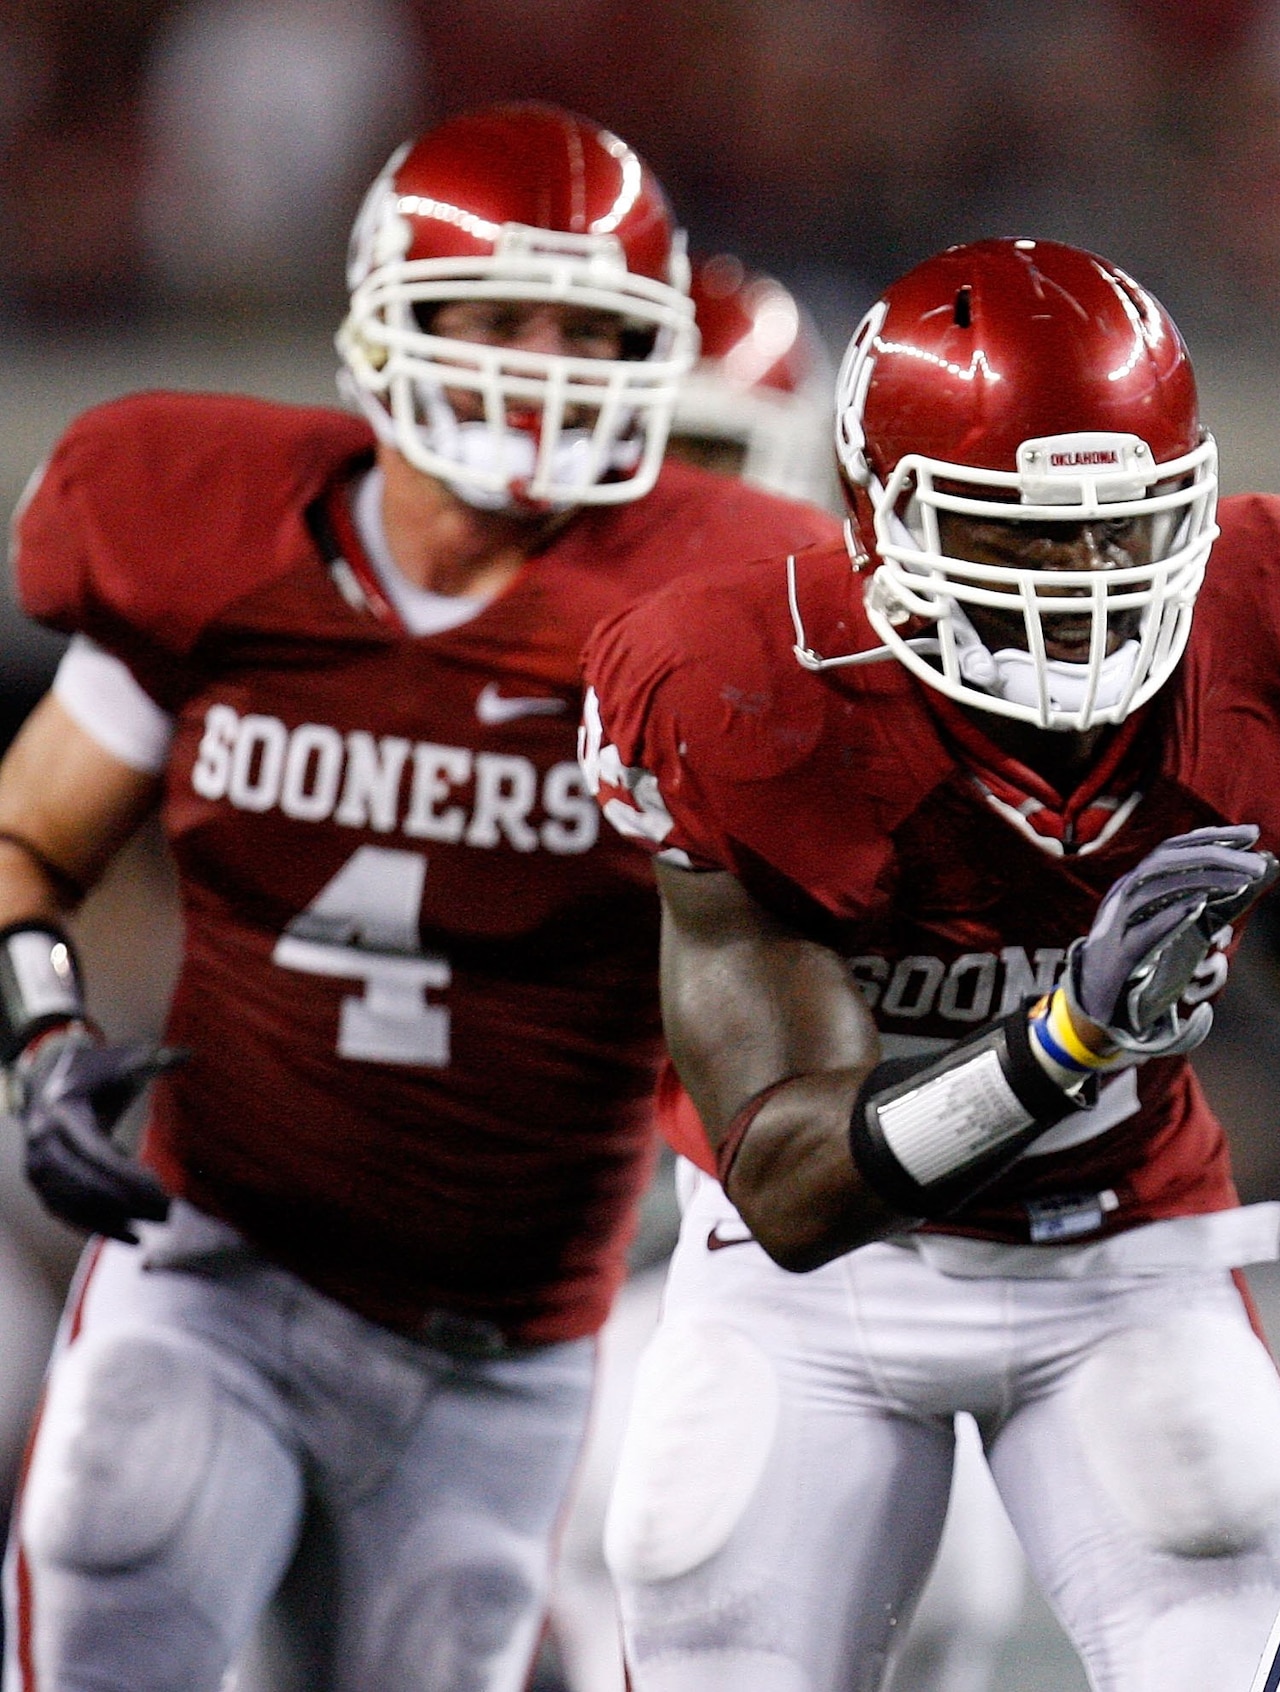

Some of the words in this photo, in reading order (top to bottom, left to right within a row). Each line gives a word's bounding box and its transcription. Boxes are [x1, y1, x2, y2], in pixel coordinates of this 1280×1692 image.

[1051, 450, 1119, 466] OKLAHOMA
[192, 704, 600, 855] SOONERS
[272, 845, 451, 1068] 4
[849, 926, 1234, 1023] SOONS
